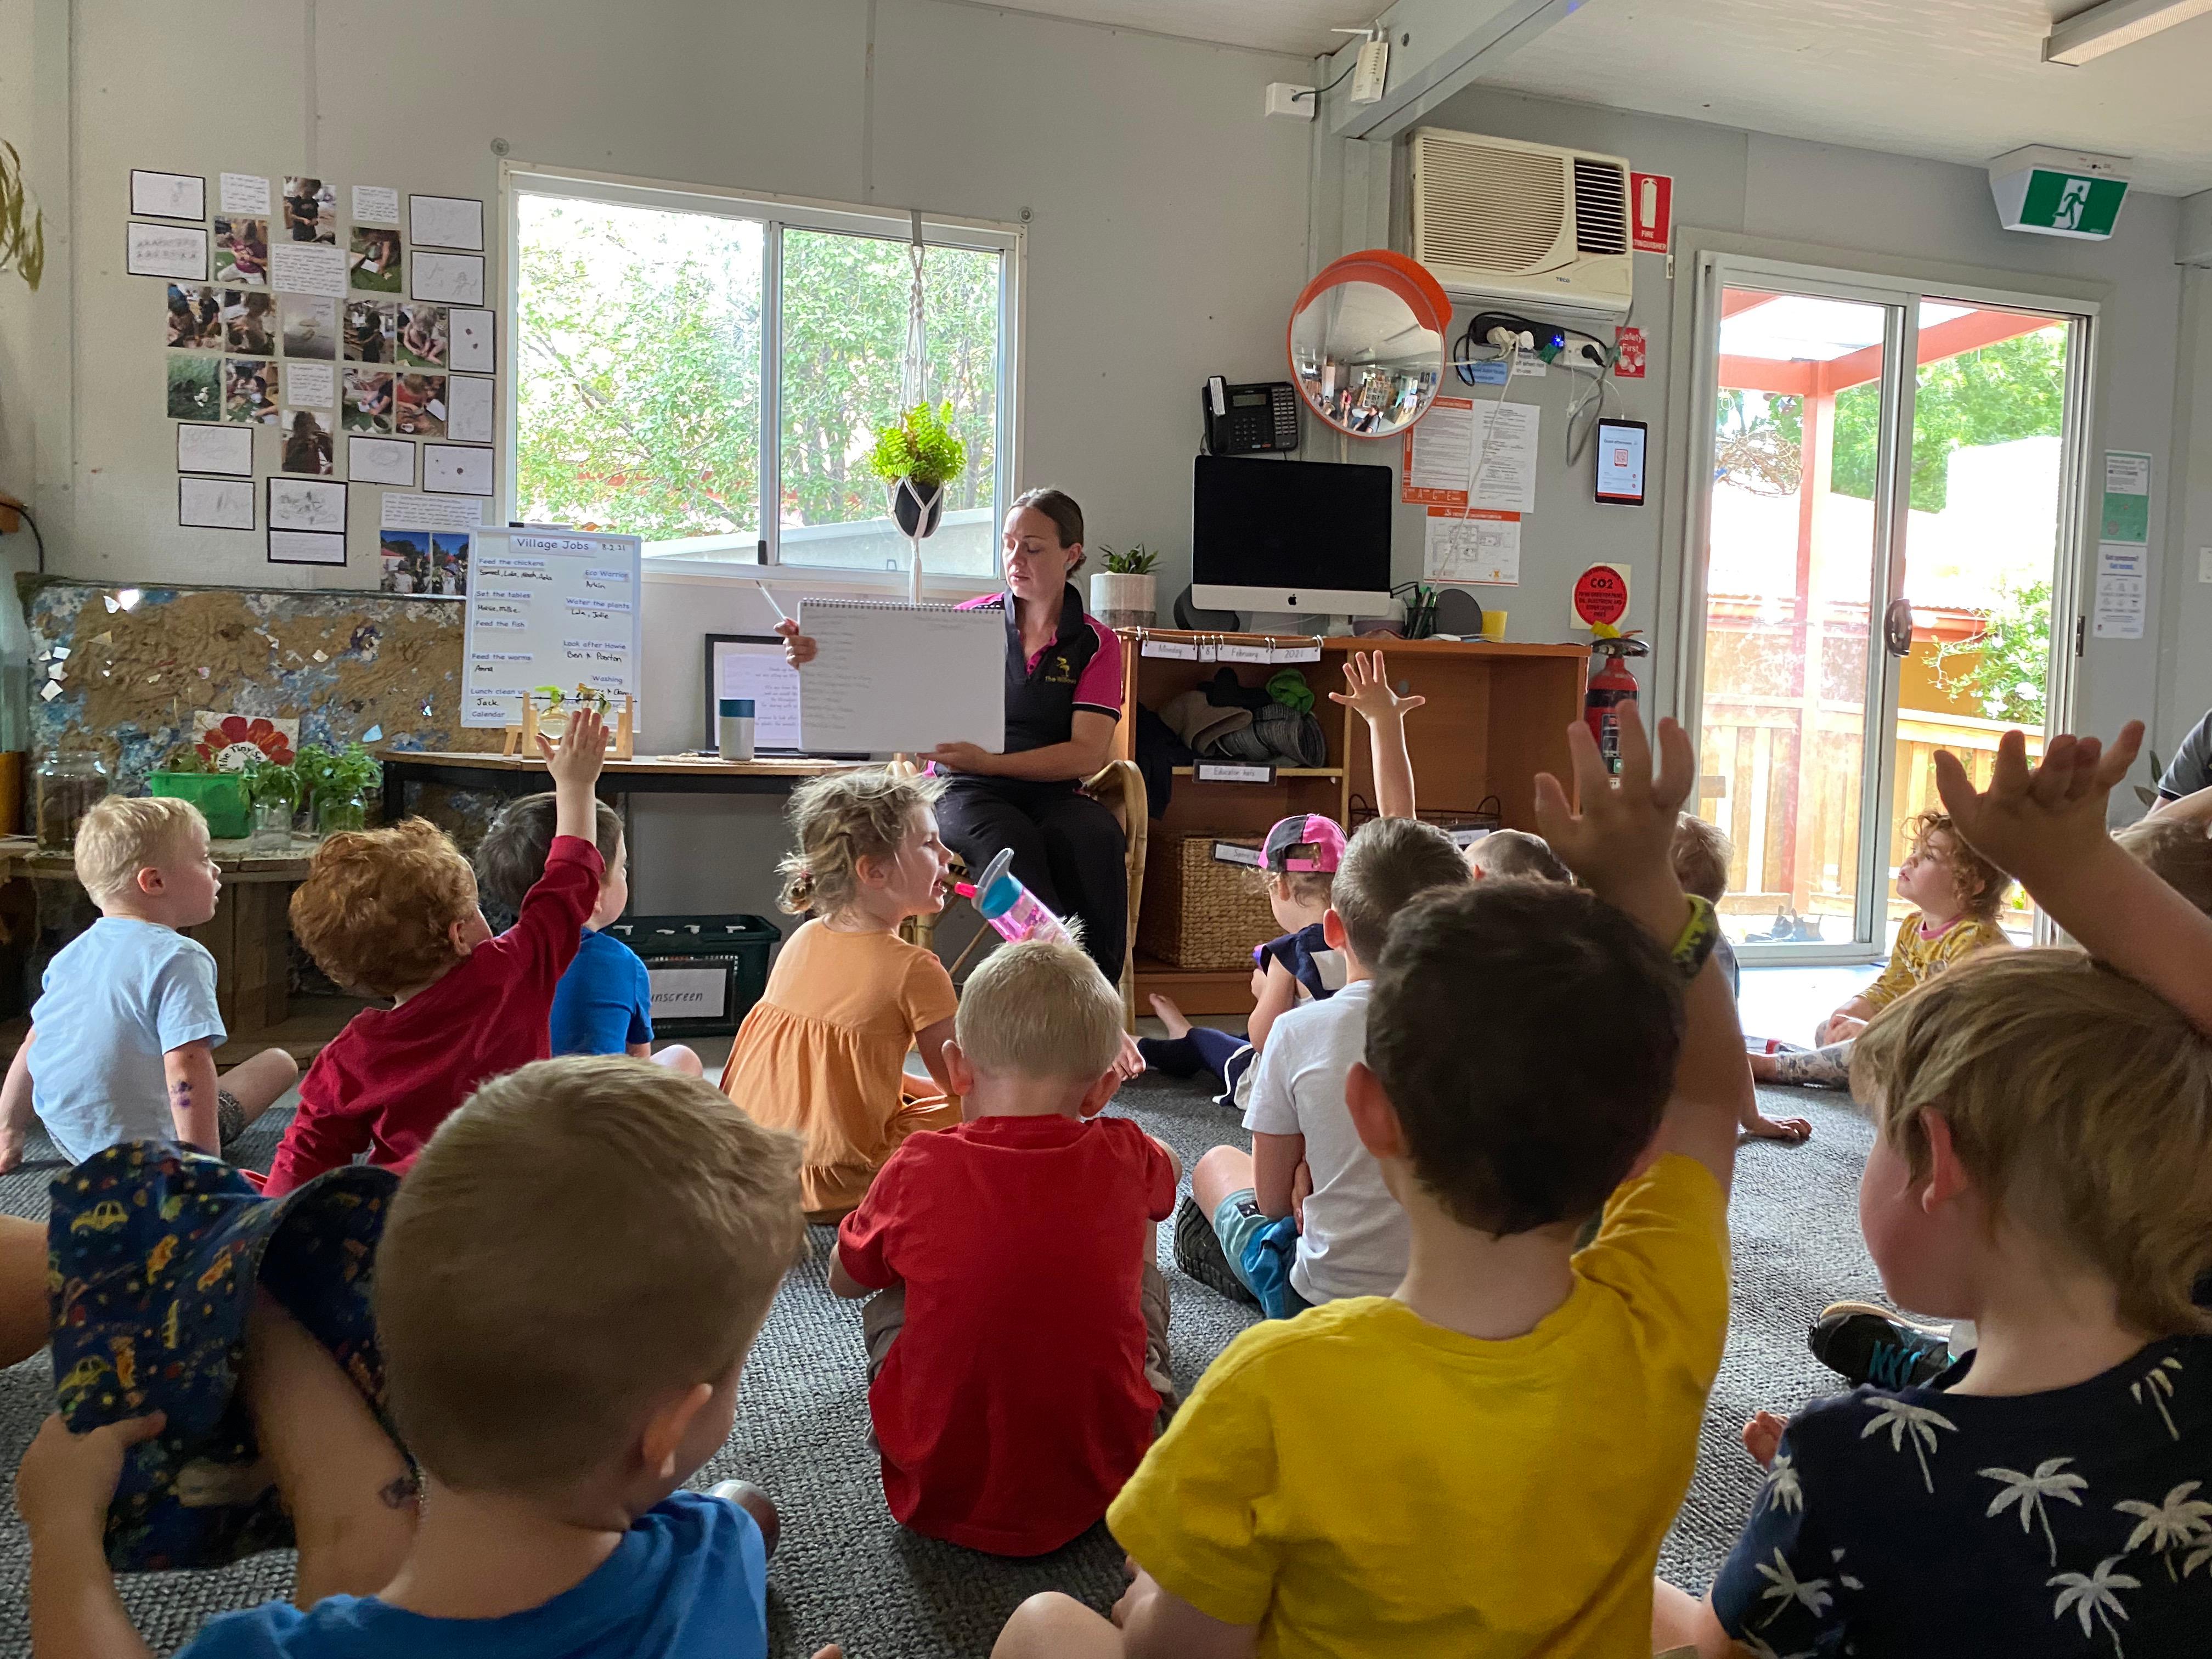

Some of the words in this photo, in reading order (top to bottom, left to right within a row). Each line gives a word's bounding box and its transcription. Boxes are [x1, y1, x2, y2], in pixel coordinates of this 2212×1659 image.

[1641, 230, 1654, 239] FIRE
[1633, 239, 1667, 251] TINGUISHER
[1622, 343, 1639, 353] First
[517, 538, 558, 551] Village
[562, 541, 589, 550] Jobs
[1590, 578, 1613, 589] CO2
[1158, 644, 1182, 657] Monday
[1205, 647, 1210, 655] 8
[1231, 649, 1259, 659] February
[1284, 650, 1304, 658] 2021
[592, 675, 623, 685] Washing
[476, 697, 499, 707] Jack
[229, 744, 255, 755] Tiny
[1214, 767, 1239, 776] Educator
